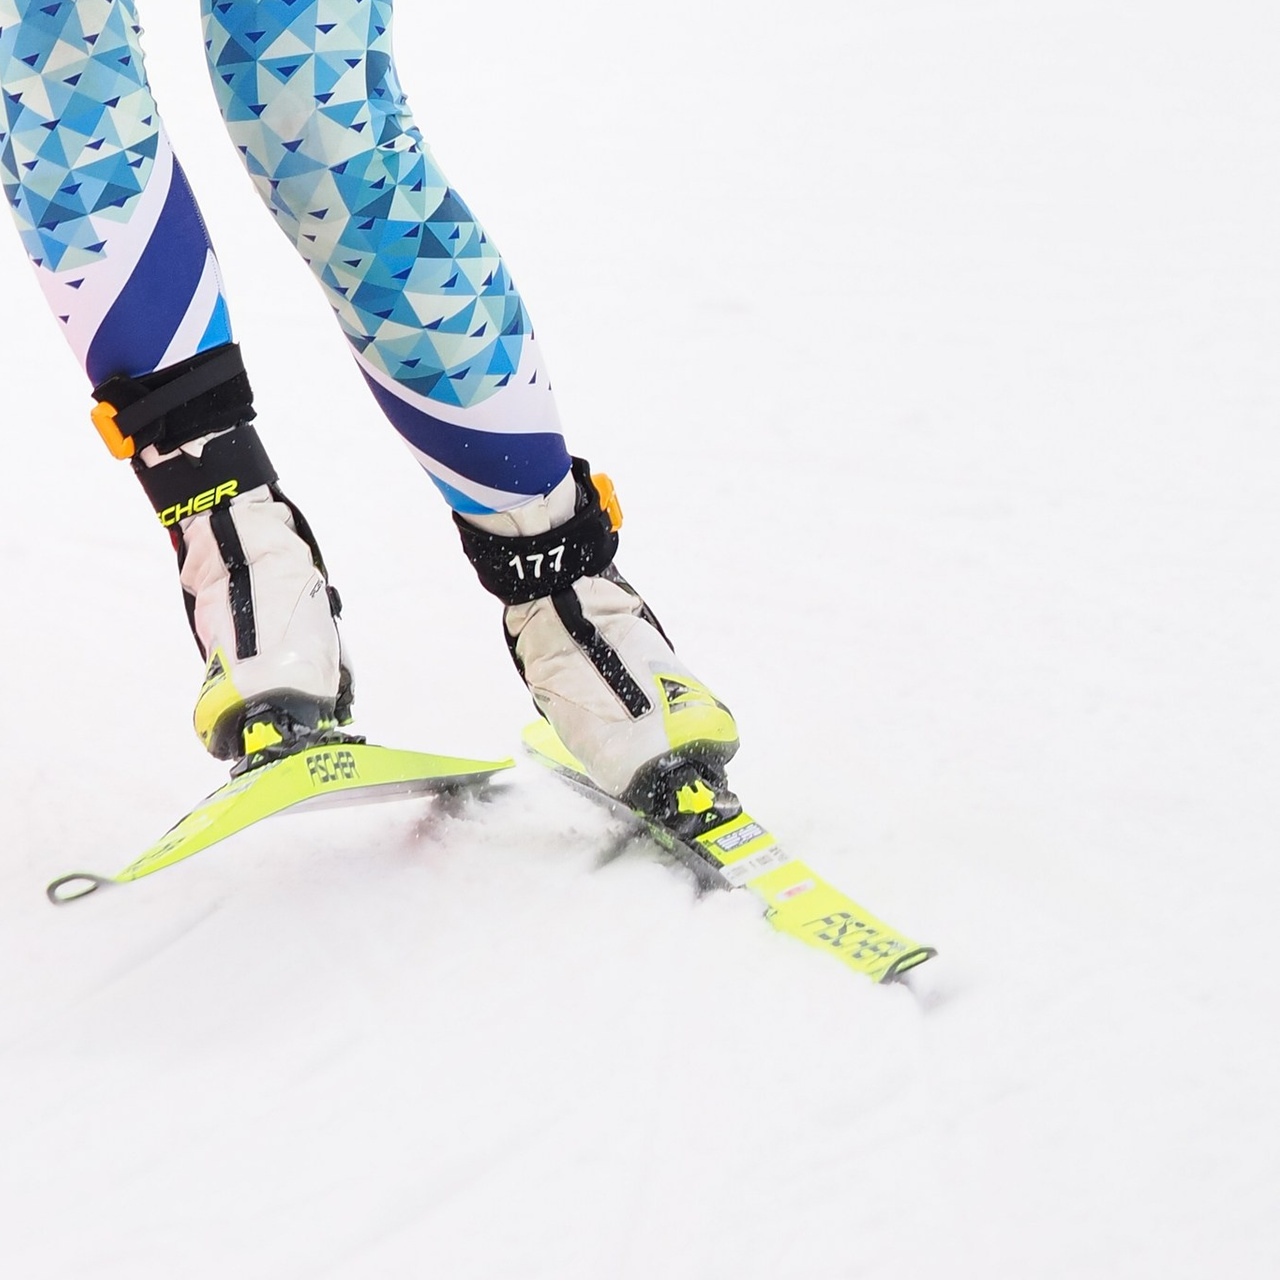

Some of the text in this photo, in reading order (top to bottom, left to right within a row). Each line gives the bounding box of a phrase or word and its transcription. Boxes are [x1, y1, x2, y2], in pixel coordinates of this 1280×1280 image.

[157, 479, 239, 527] CHER
[508, 544, 565, 580] 177
[306, 751, 360, 787] FISCHER
